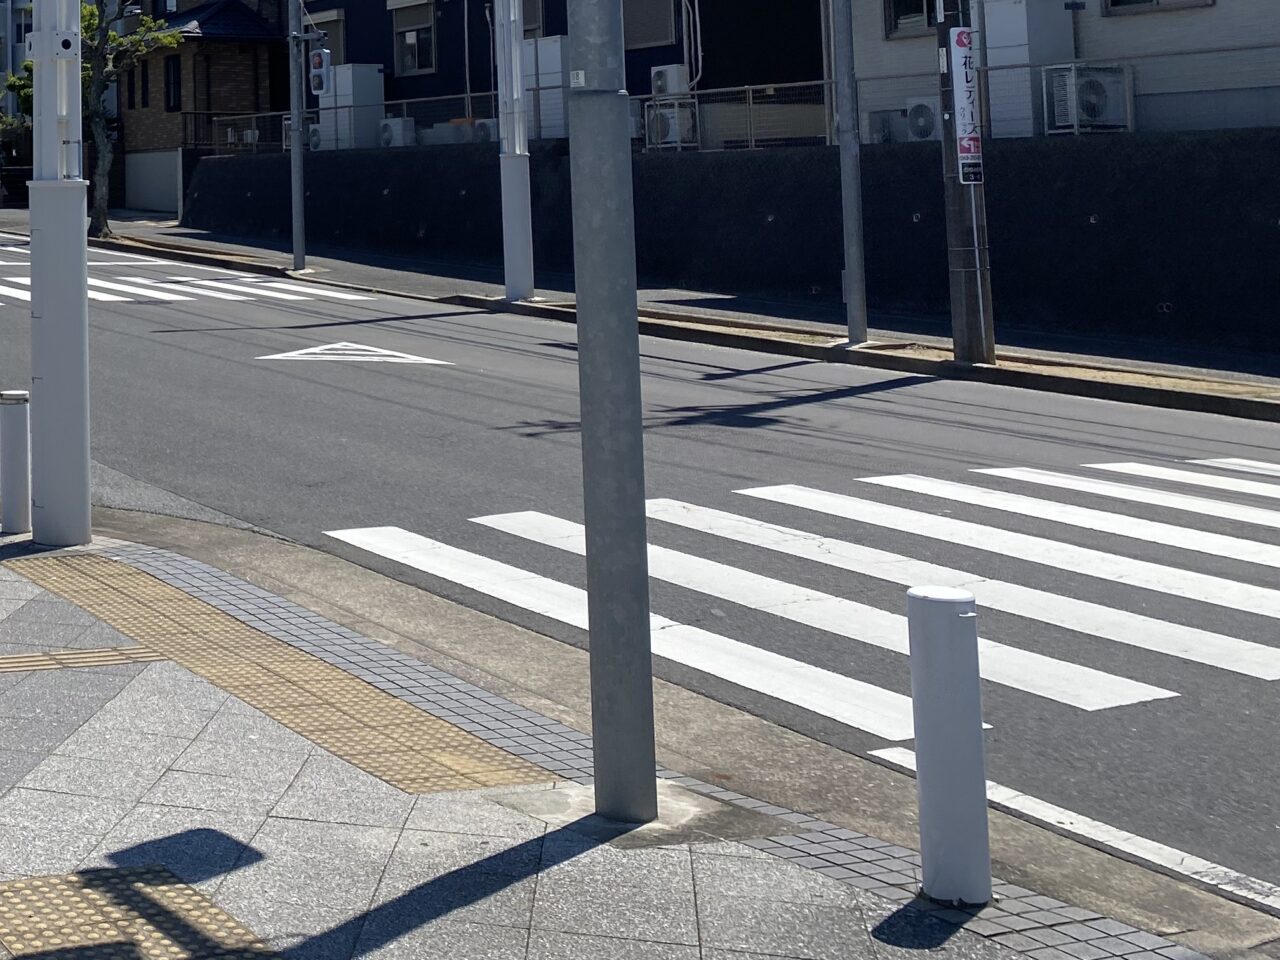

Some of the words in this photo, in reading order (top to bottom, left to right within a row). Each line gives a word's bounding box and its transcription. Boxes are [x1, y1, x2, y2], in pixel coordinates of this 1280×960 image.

[962, 56, 978, 135] 花レディース
